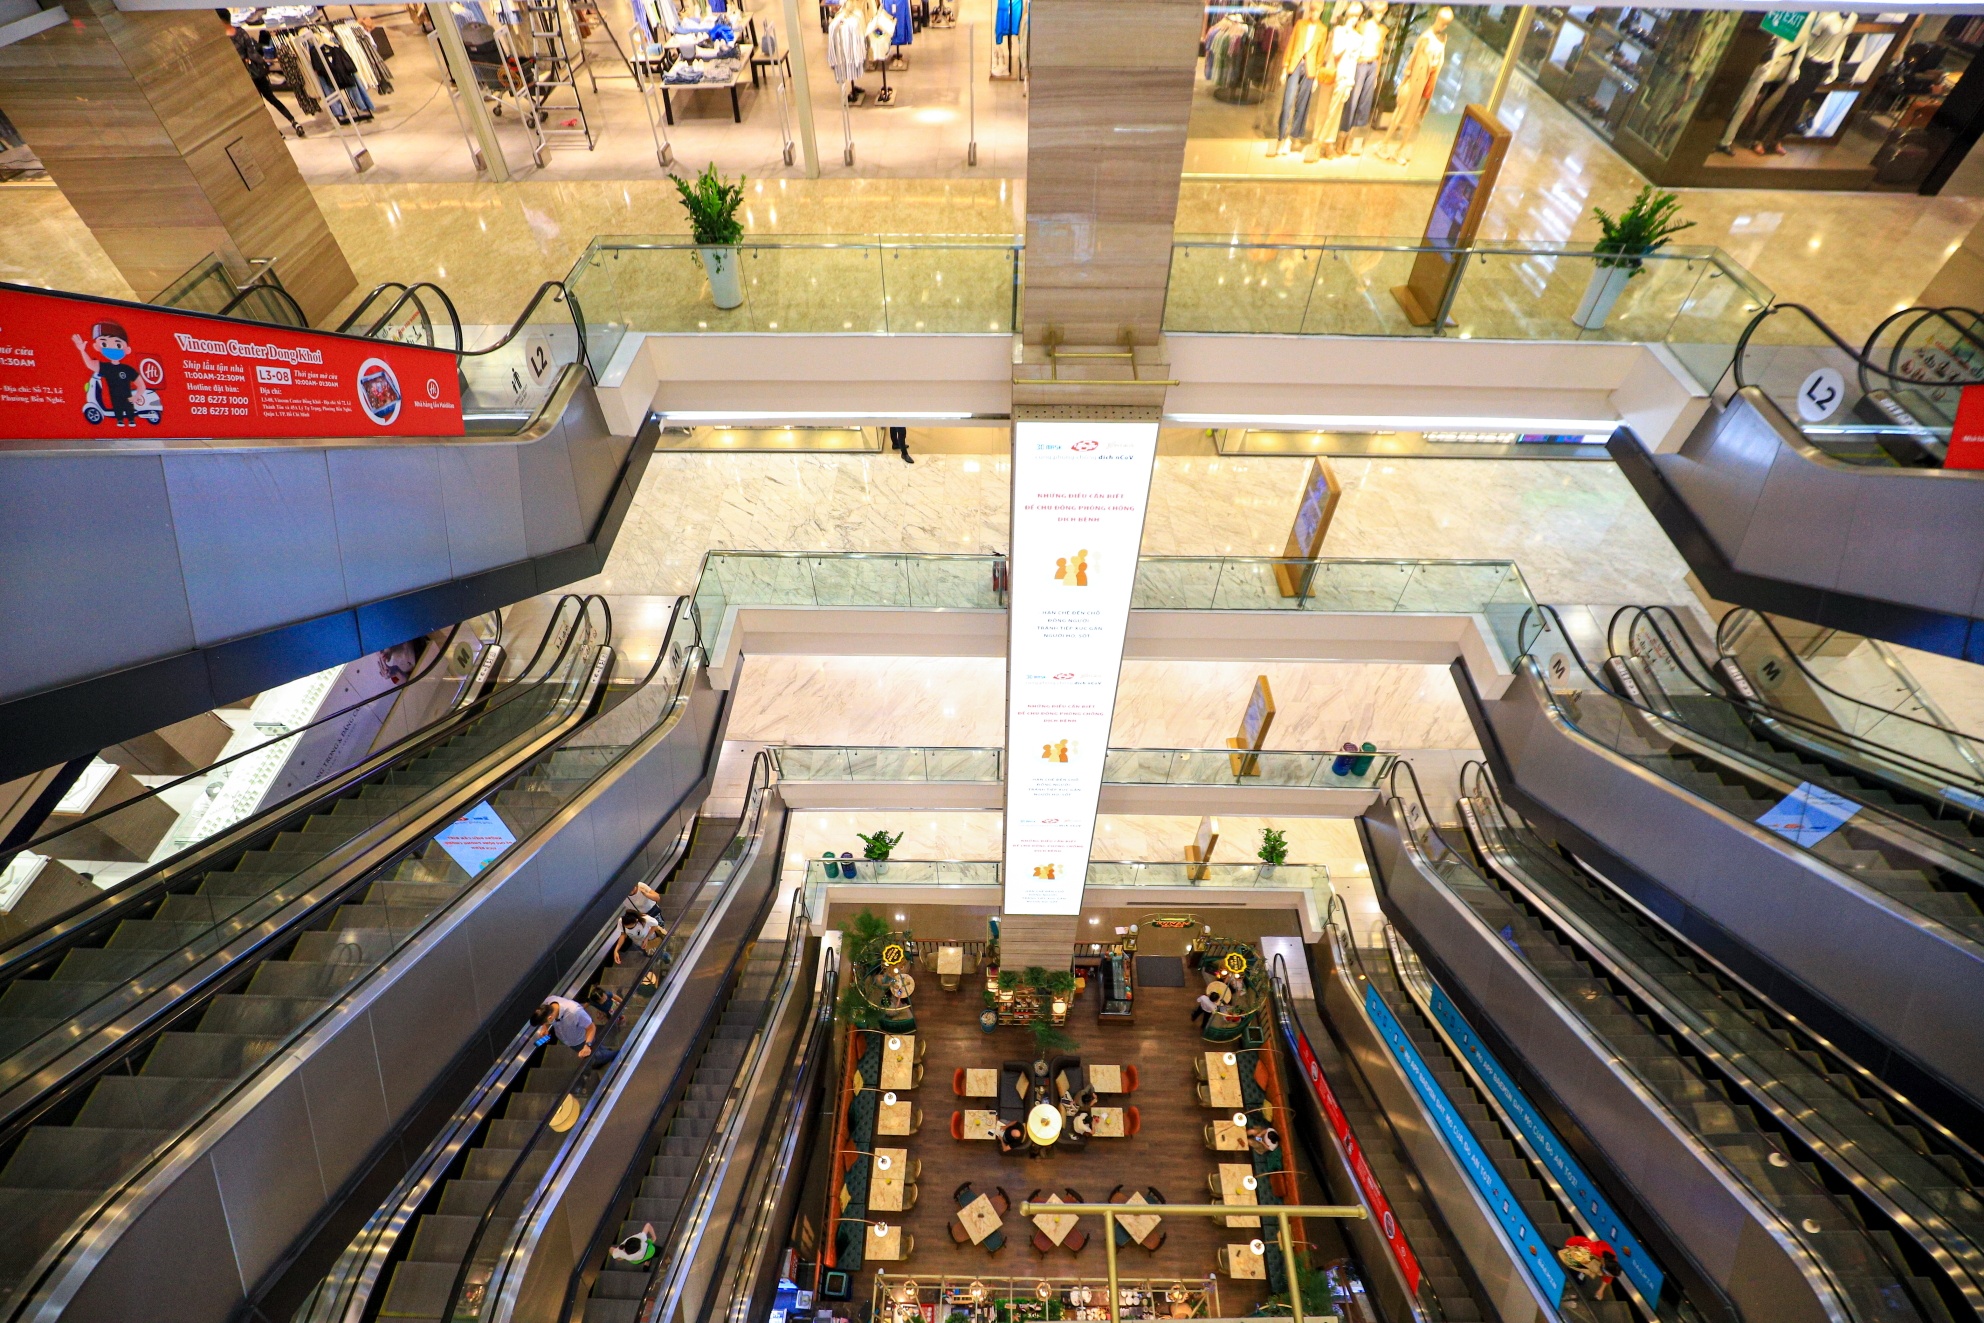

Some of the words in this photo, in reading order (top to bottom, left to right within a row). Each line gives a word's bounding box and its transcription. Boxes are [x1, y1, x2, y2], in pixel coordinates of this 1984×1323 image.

[1784, 11, 1806, 27] EXIT
[174, 334, 226, 354] Vincom
[228, 340, 266, 358] Center
[268, 346, 298, 364] Dong
[298, 348, 322, 363] Khoi
[0, 358, 35, 366] 1:30AM
[183, 360, 200, 370] Ship
[530, 346, 548, 378] L2
[184, 371, 245, 382] 11:00AM-22:30PM
[259, 370, 289, 382] L3-08
[187, 383, 211, 392] Hotline
[1806, 376, 1836, 411] L2
[189, 395, 206, 403] 028
[208, 396, 227, 404] 6273
[191, 407, 208, 415] 028
[209, 407, 229, 415] 6273
[231, 408, 248, 416] 1001
[458, 648, 470, 668] M
[671, 648, 680, 669] M
[1552, 659, 1566, 679] M
[1762, 660, 1780, 681] M
[1419, 1072, 1436, 1102] BAEMIN
[1493, 1073, 1513, 1102] BAEMIN
